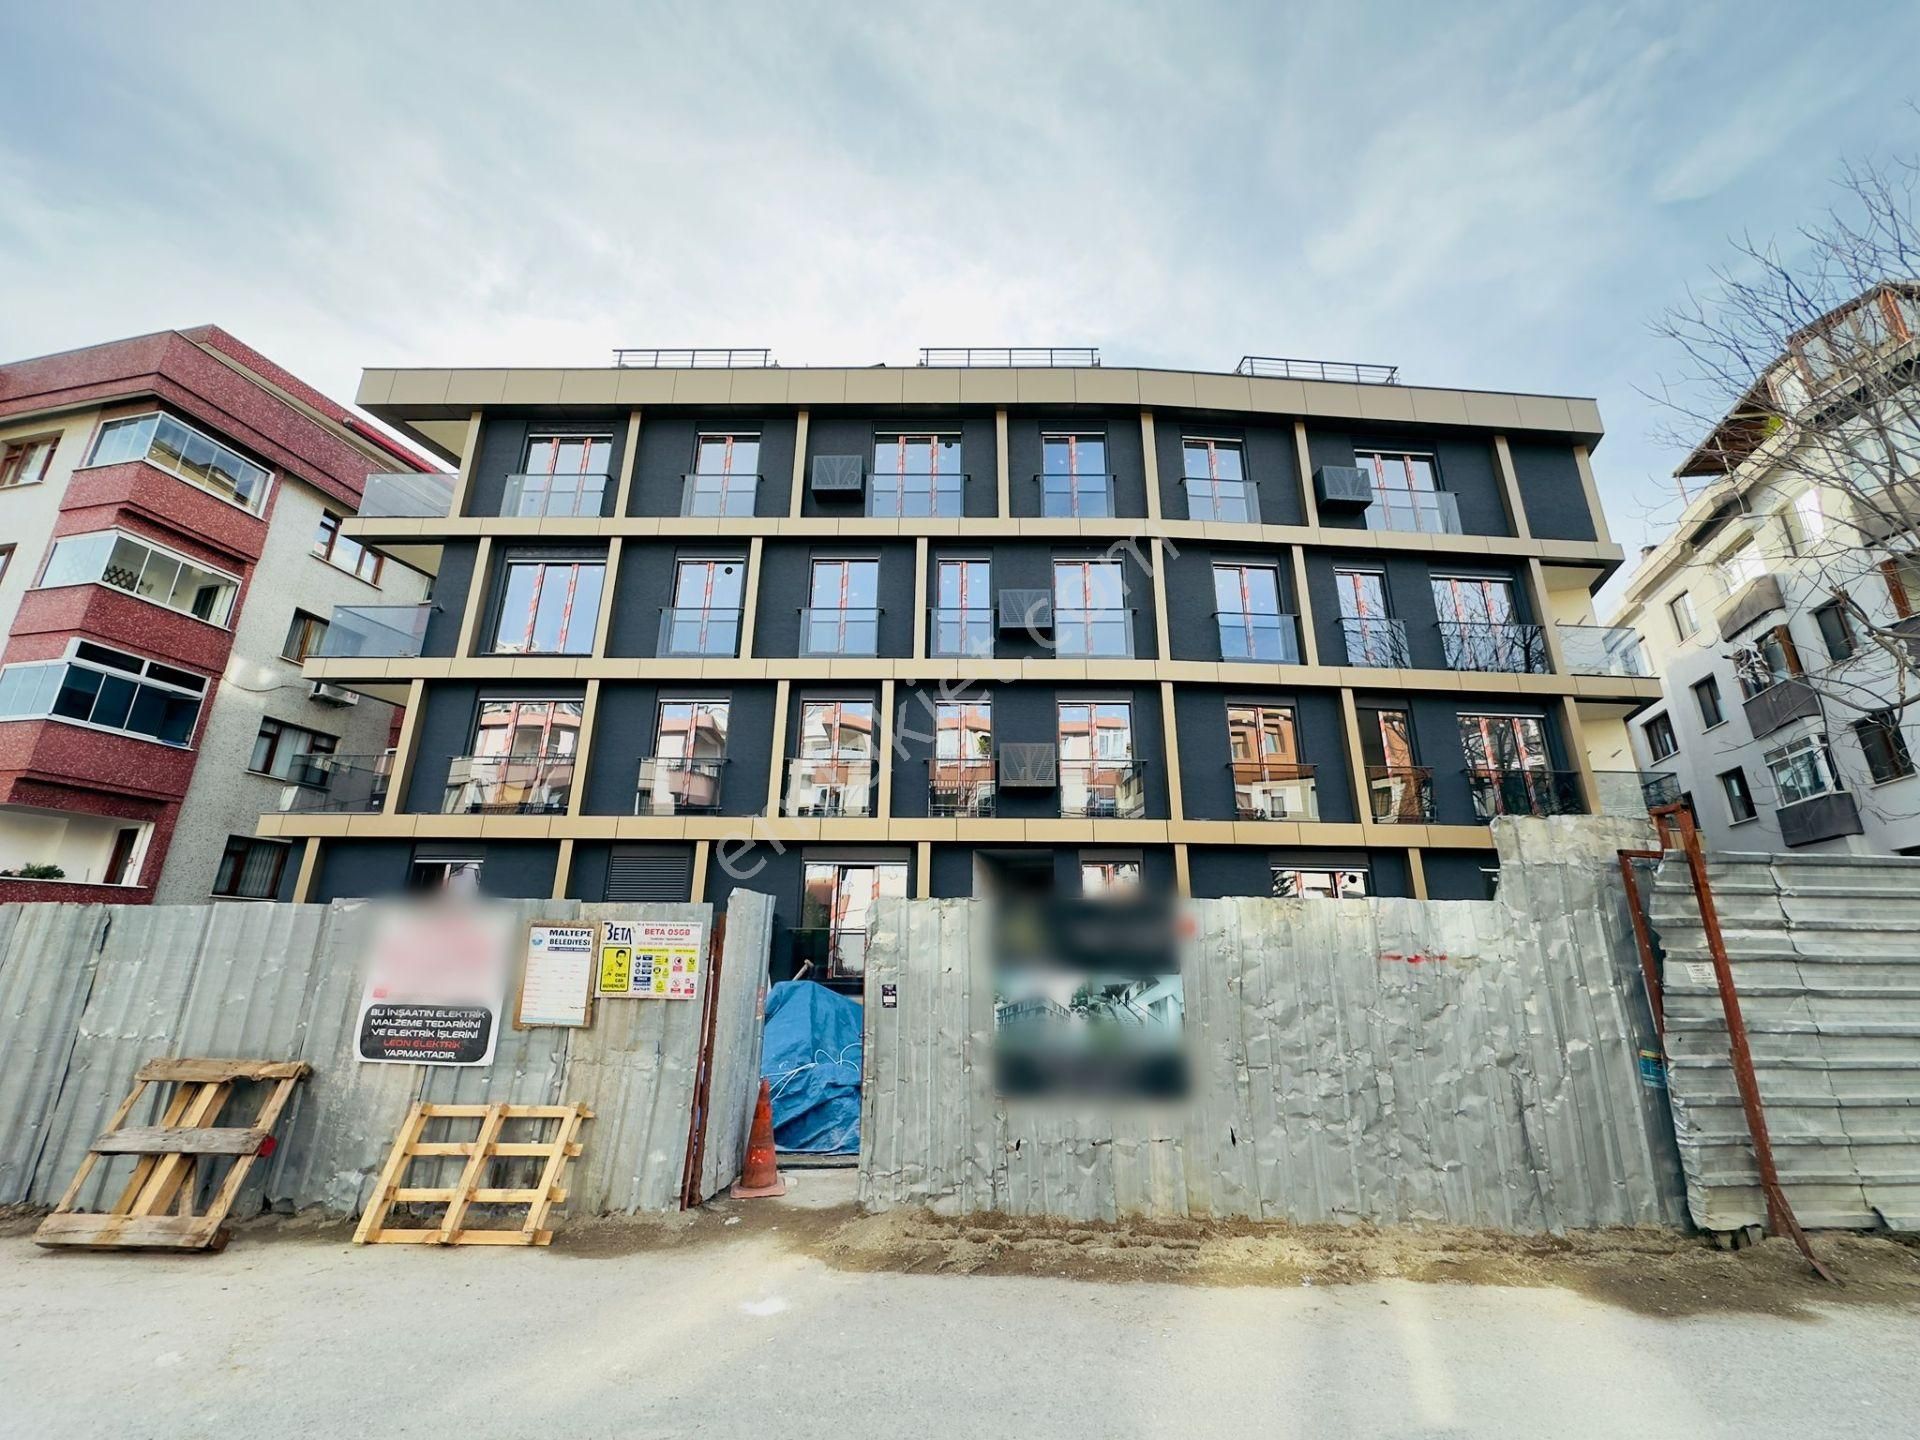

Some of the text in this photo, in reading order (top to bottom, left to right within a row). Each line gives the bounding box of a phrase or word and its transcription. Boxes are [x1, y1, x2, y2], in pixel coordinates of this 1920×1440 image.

[549, 929, 593, 938] MALTEPE
[603, 922, 632, 945] BETA
[644, 928, 665, 936] BETA
[370, 1008, 486, 1019] BU İNŞAATIN ELEKTRİK
[371, 1018, 481, 1029] MALZEME TEDARİKİNİ
[371, 1028, 479, 1039] VE ELEKTRİK İŞLERİNİ
[383, 1039, 462, 1049] LEON ELEKTRİK
[383, 1049, 457, 1060] YAPMAKTADIR.
